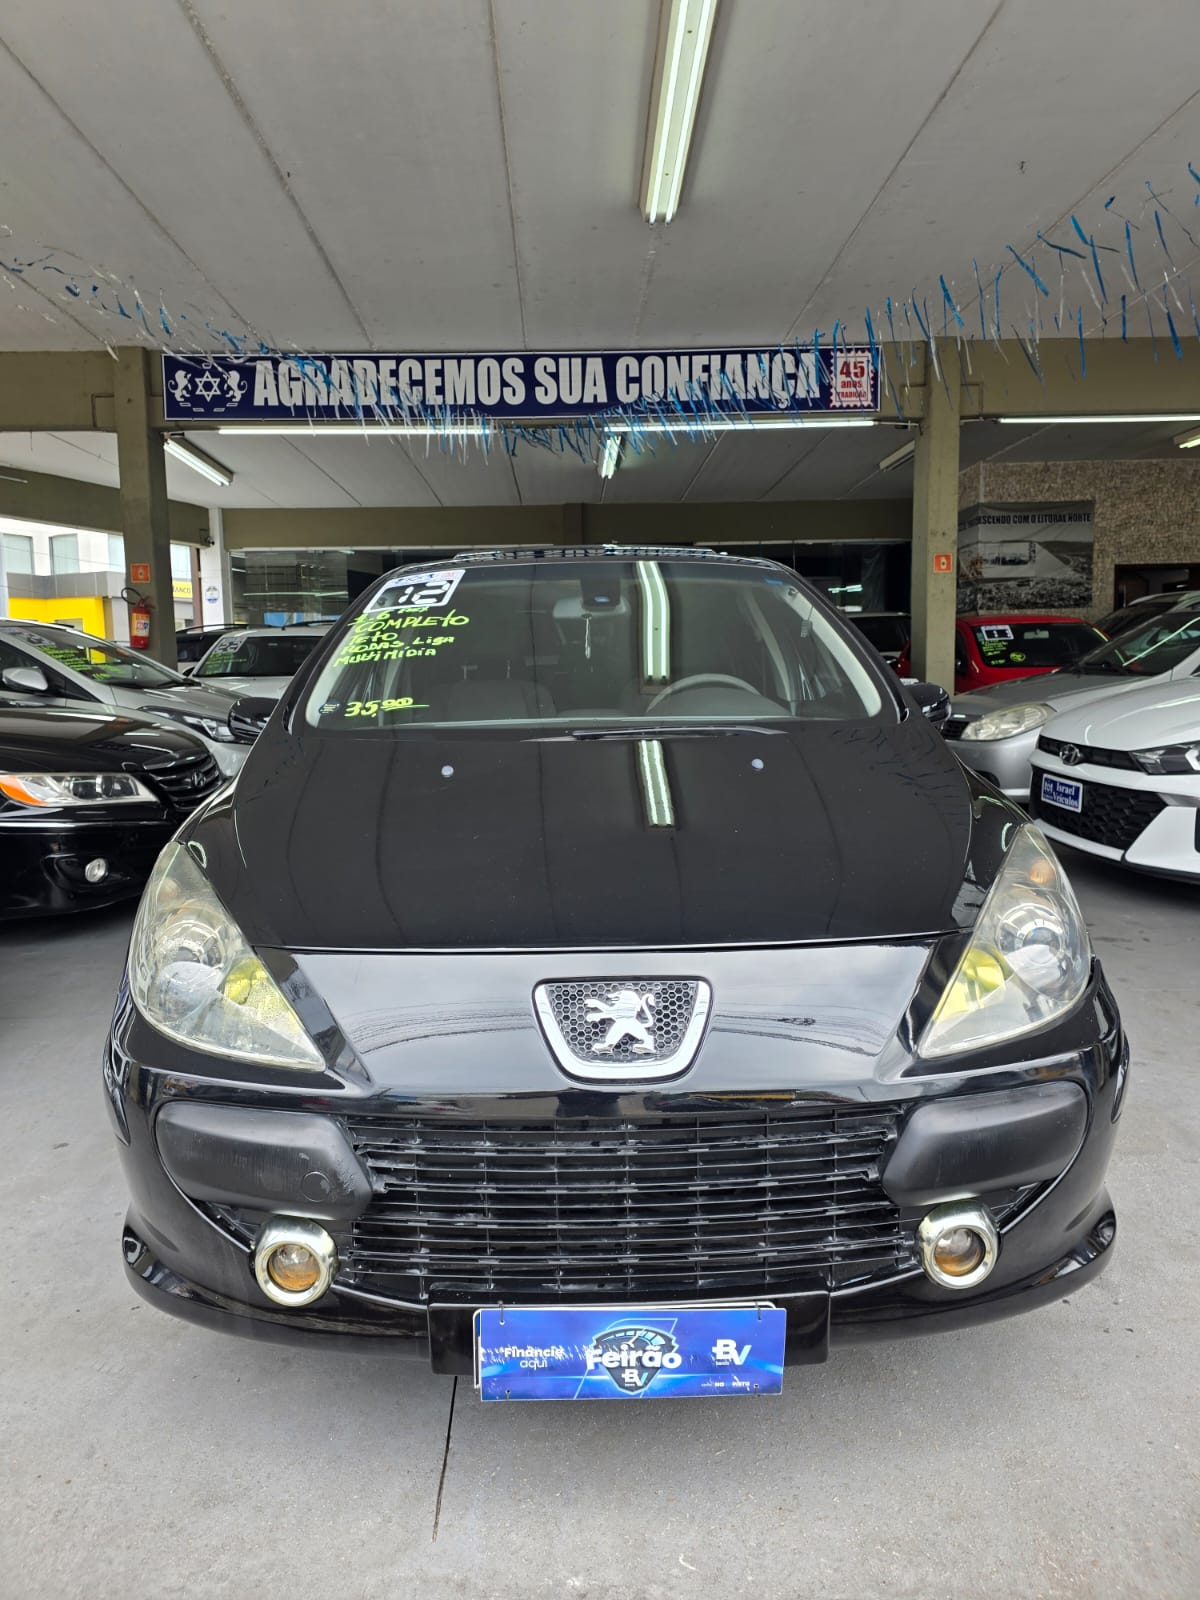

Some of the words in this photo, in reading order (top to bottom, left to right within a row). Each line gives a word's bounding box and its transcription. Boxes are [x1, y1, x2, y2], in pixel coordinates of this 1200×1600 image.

[840, 360, 865, 378] 45
[253, 358, 526, 406] AGRADECEMOS
[534, 357, 607, 405] SUA
[615, 352, 820, 409] CONFIANÇA
[1012, 514, 1029, 524] COM
[397, 580, 451, 605] 12
[586, 1343, 682, 1369] Feirão
[711, 1339, 752, 1366] BV
[519, 1359, 548, 1370] aqui
[621, 1368, 648, 1387] BV
